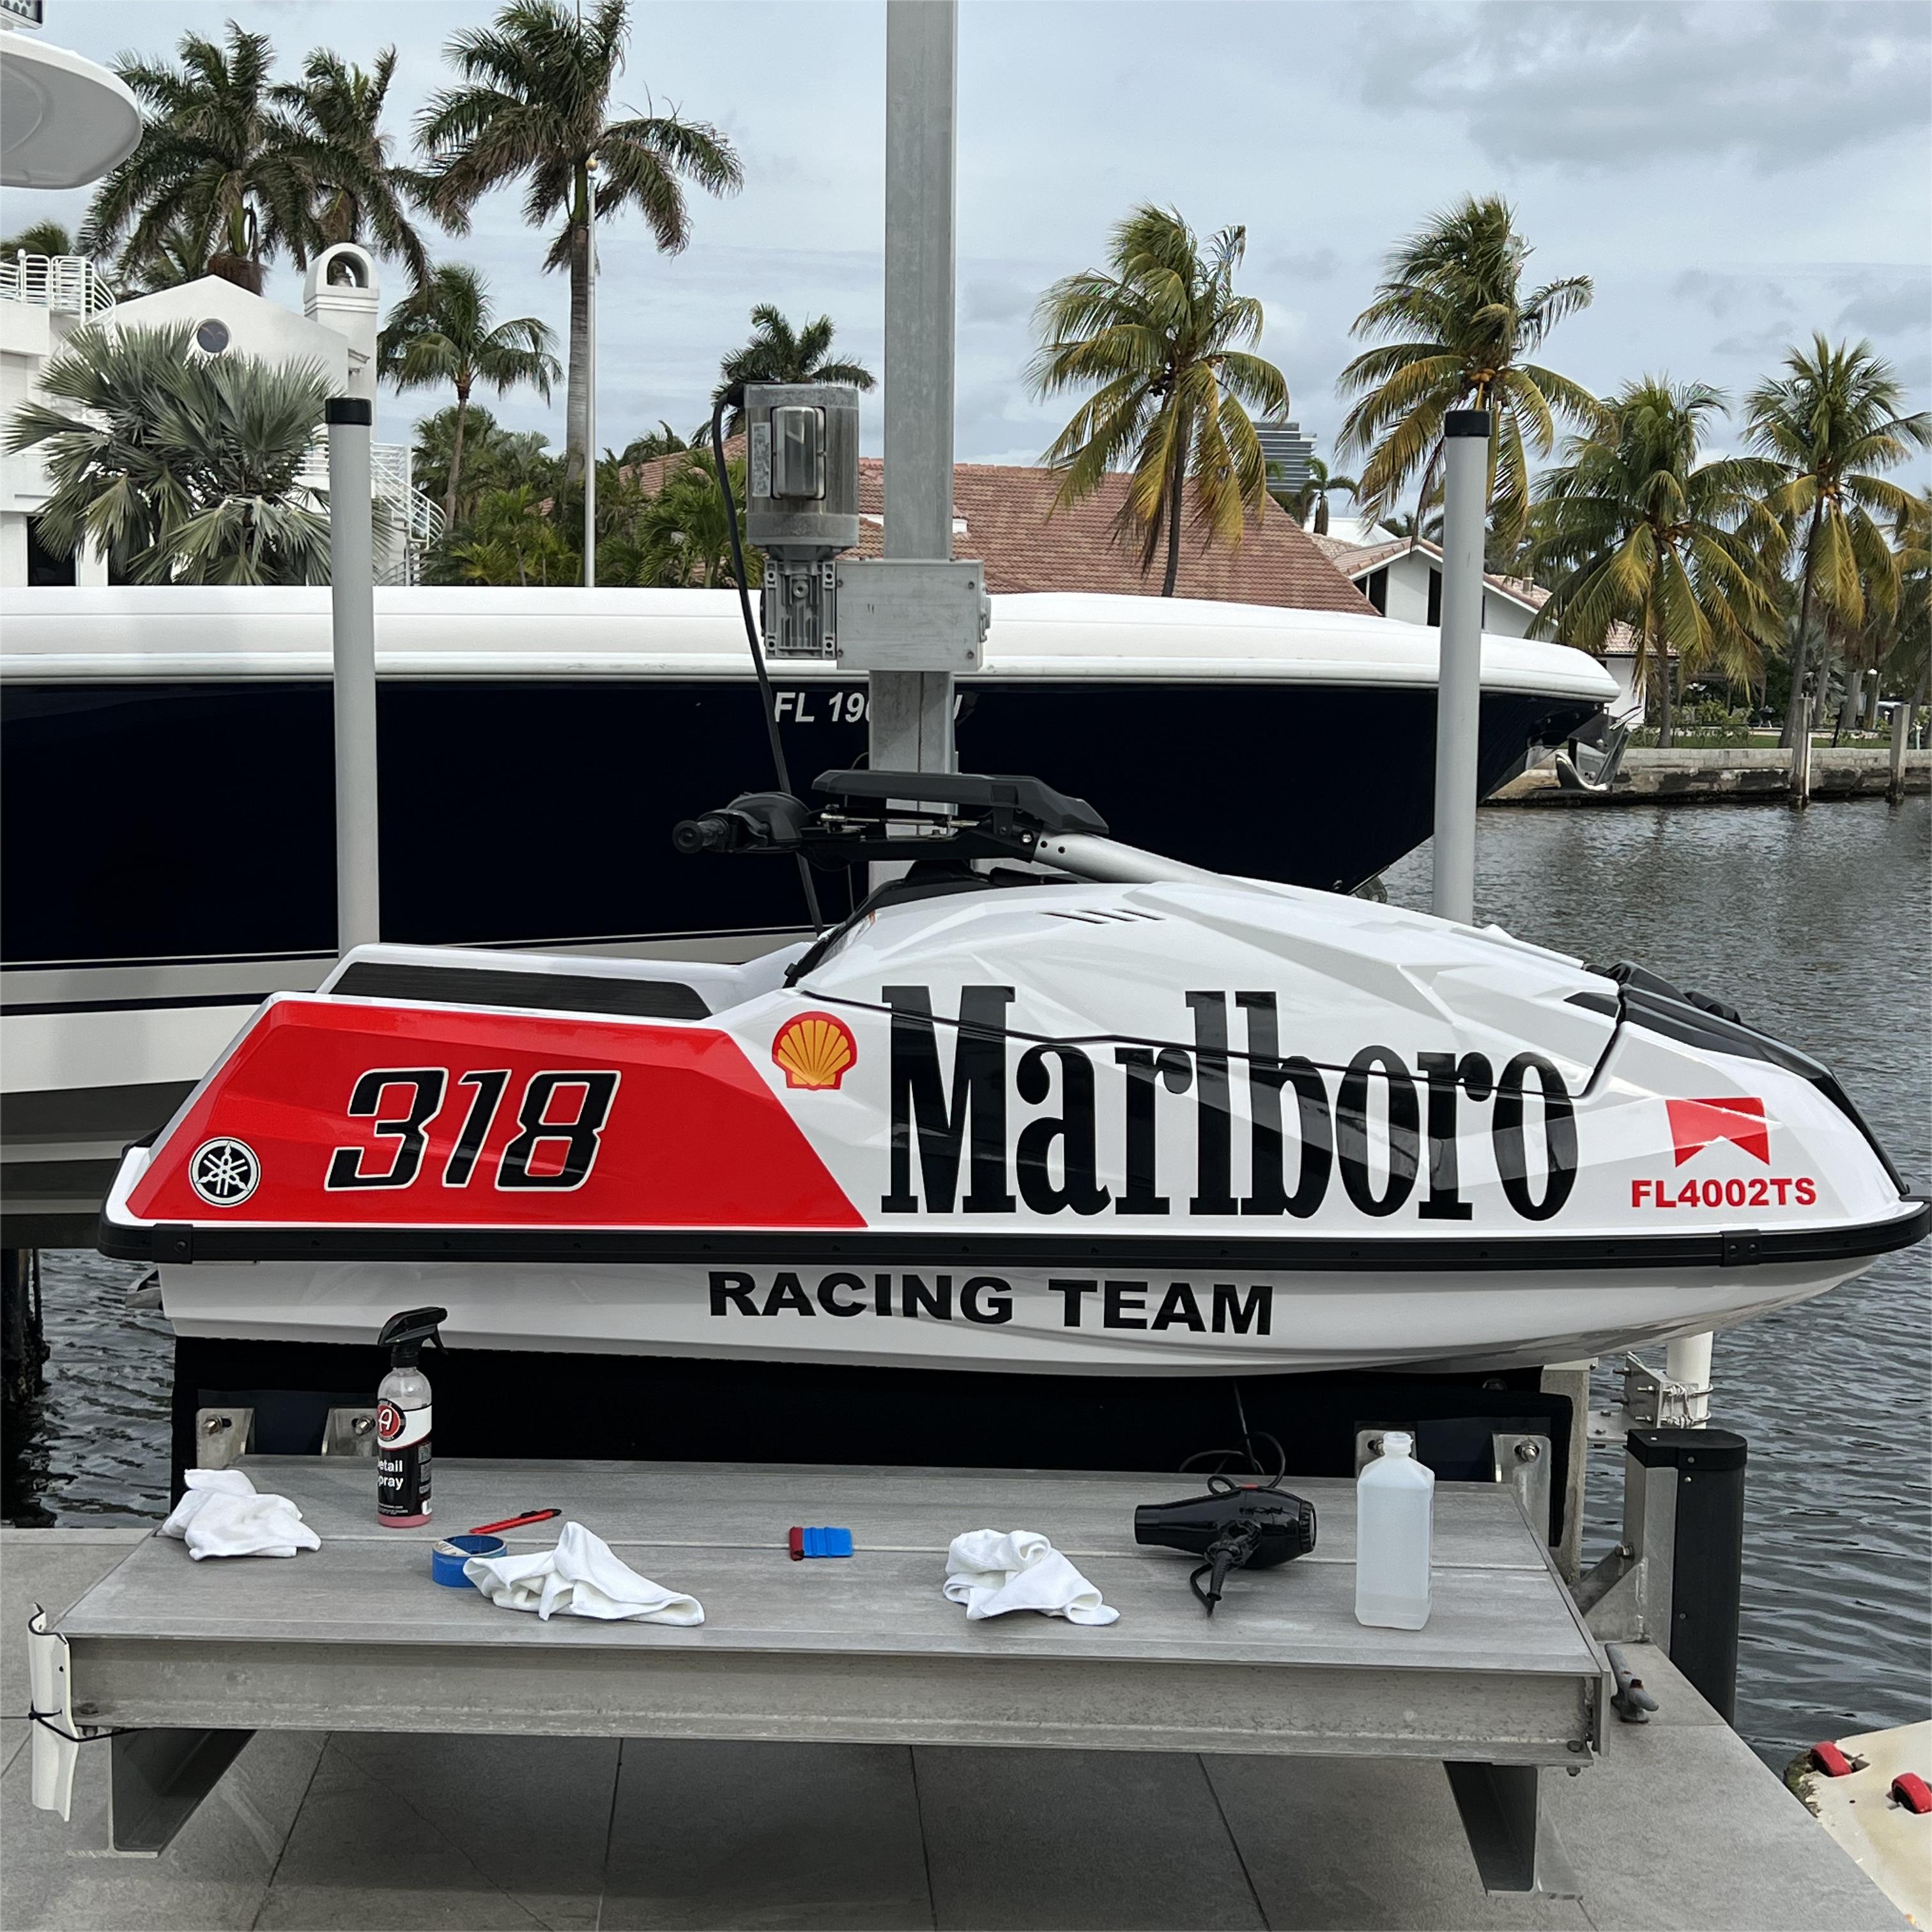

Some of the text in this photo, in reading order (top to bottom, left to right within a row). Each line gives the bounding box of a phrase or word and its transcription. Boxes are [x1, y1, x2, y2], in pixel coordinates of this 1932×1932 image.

[774, 692, 870, 723] FL 19
[881, 985, 1579, 1222] Marlboro
[325, 1067, 622, 1192] 318
[1631, 1177, 1817, 1208] FL4002TS
[708, 1271, 1273, 1335] RACING TEAM
[378, 1459, 403, 1472] etail
[378, 1475, 404, 1491] pray
